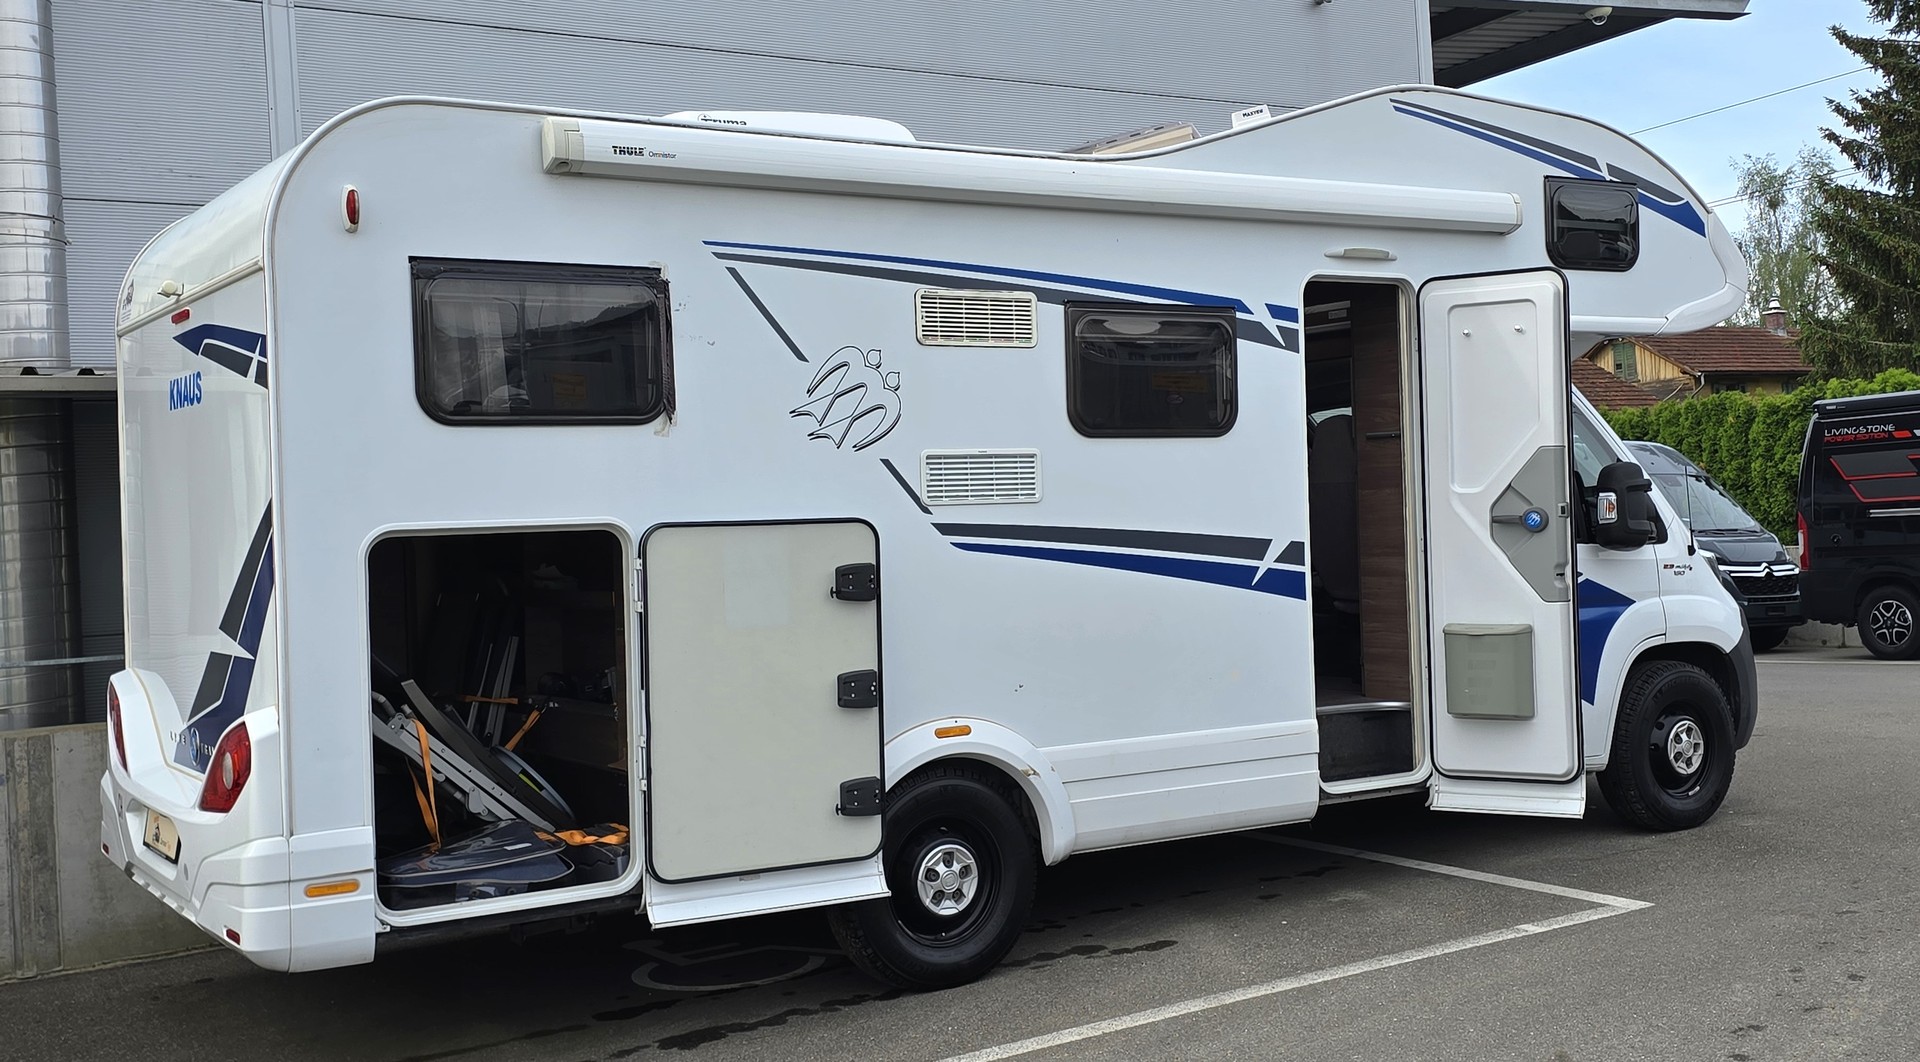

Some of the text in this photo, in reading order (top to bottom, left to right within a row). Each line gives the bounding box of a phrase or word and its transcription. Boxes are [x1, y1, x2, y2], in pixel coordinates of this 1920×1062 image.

[611, 145, 677, 159] THULE Omnistor
[169, 371, 202, 411] KNAUS
[1824, 423, 1896, 437] LIVINGSTONE
[1824, 432, 1889, 443] POWER EDITION
